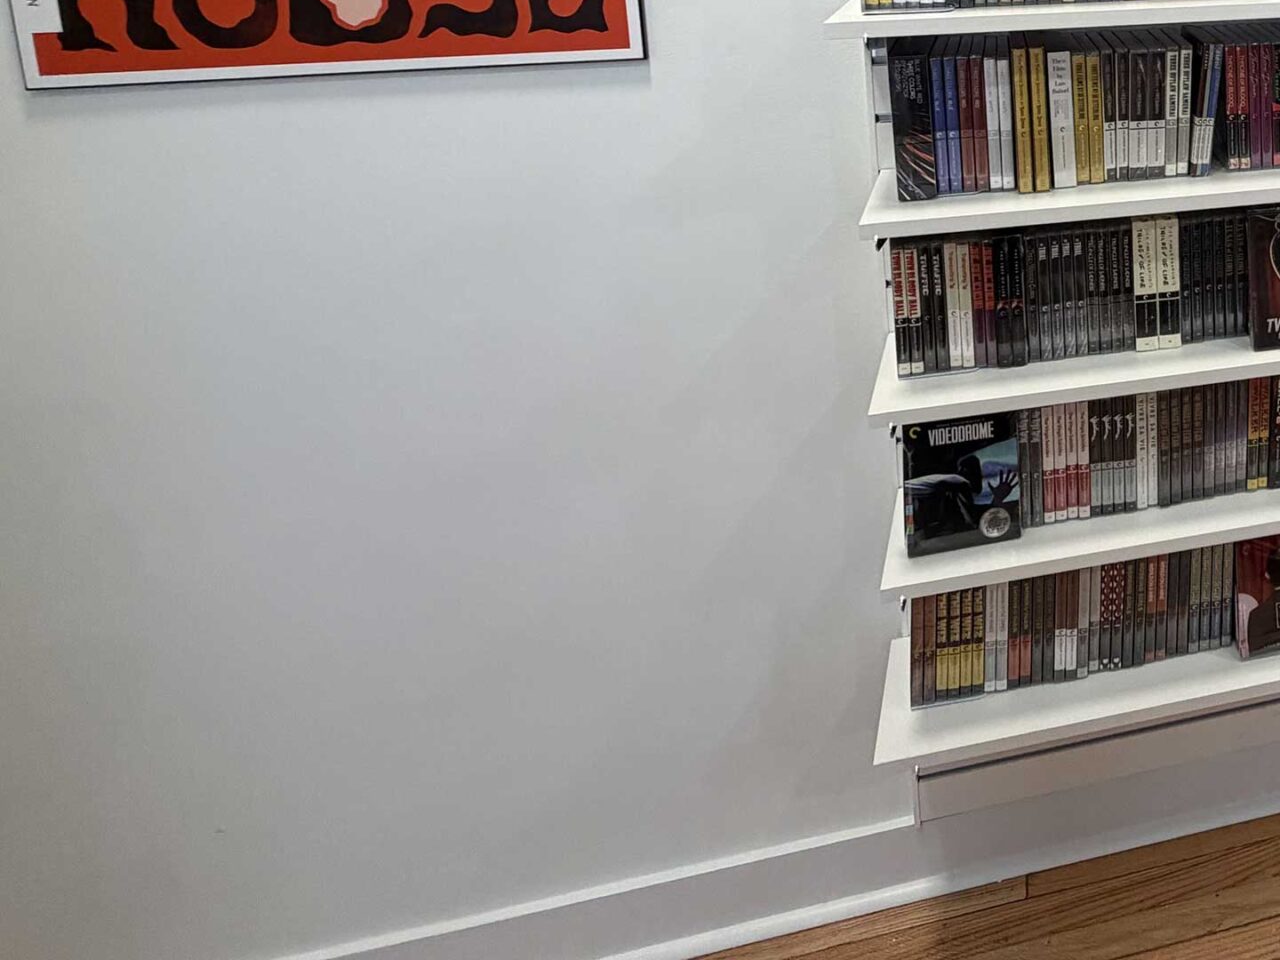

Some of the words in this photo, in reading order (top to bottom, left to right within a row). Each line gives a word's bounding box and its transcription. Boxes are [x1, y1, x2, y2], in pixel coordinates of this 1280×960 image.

[896, 301, 905, 318] HALL
[909, 300, 918, 317] HALL
[928, 421, 994, 447] VIDEODROME
